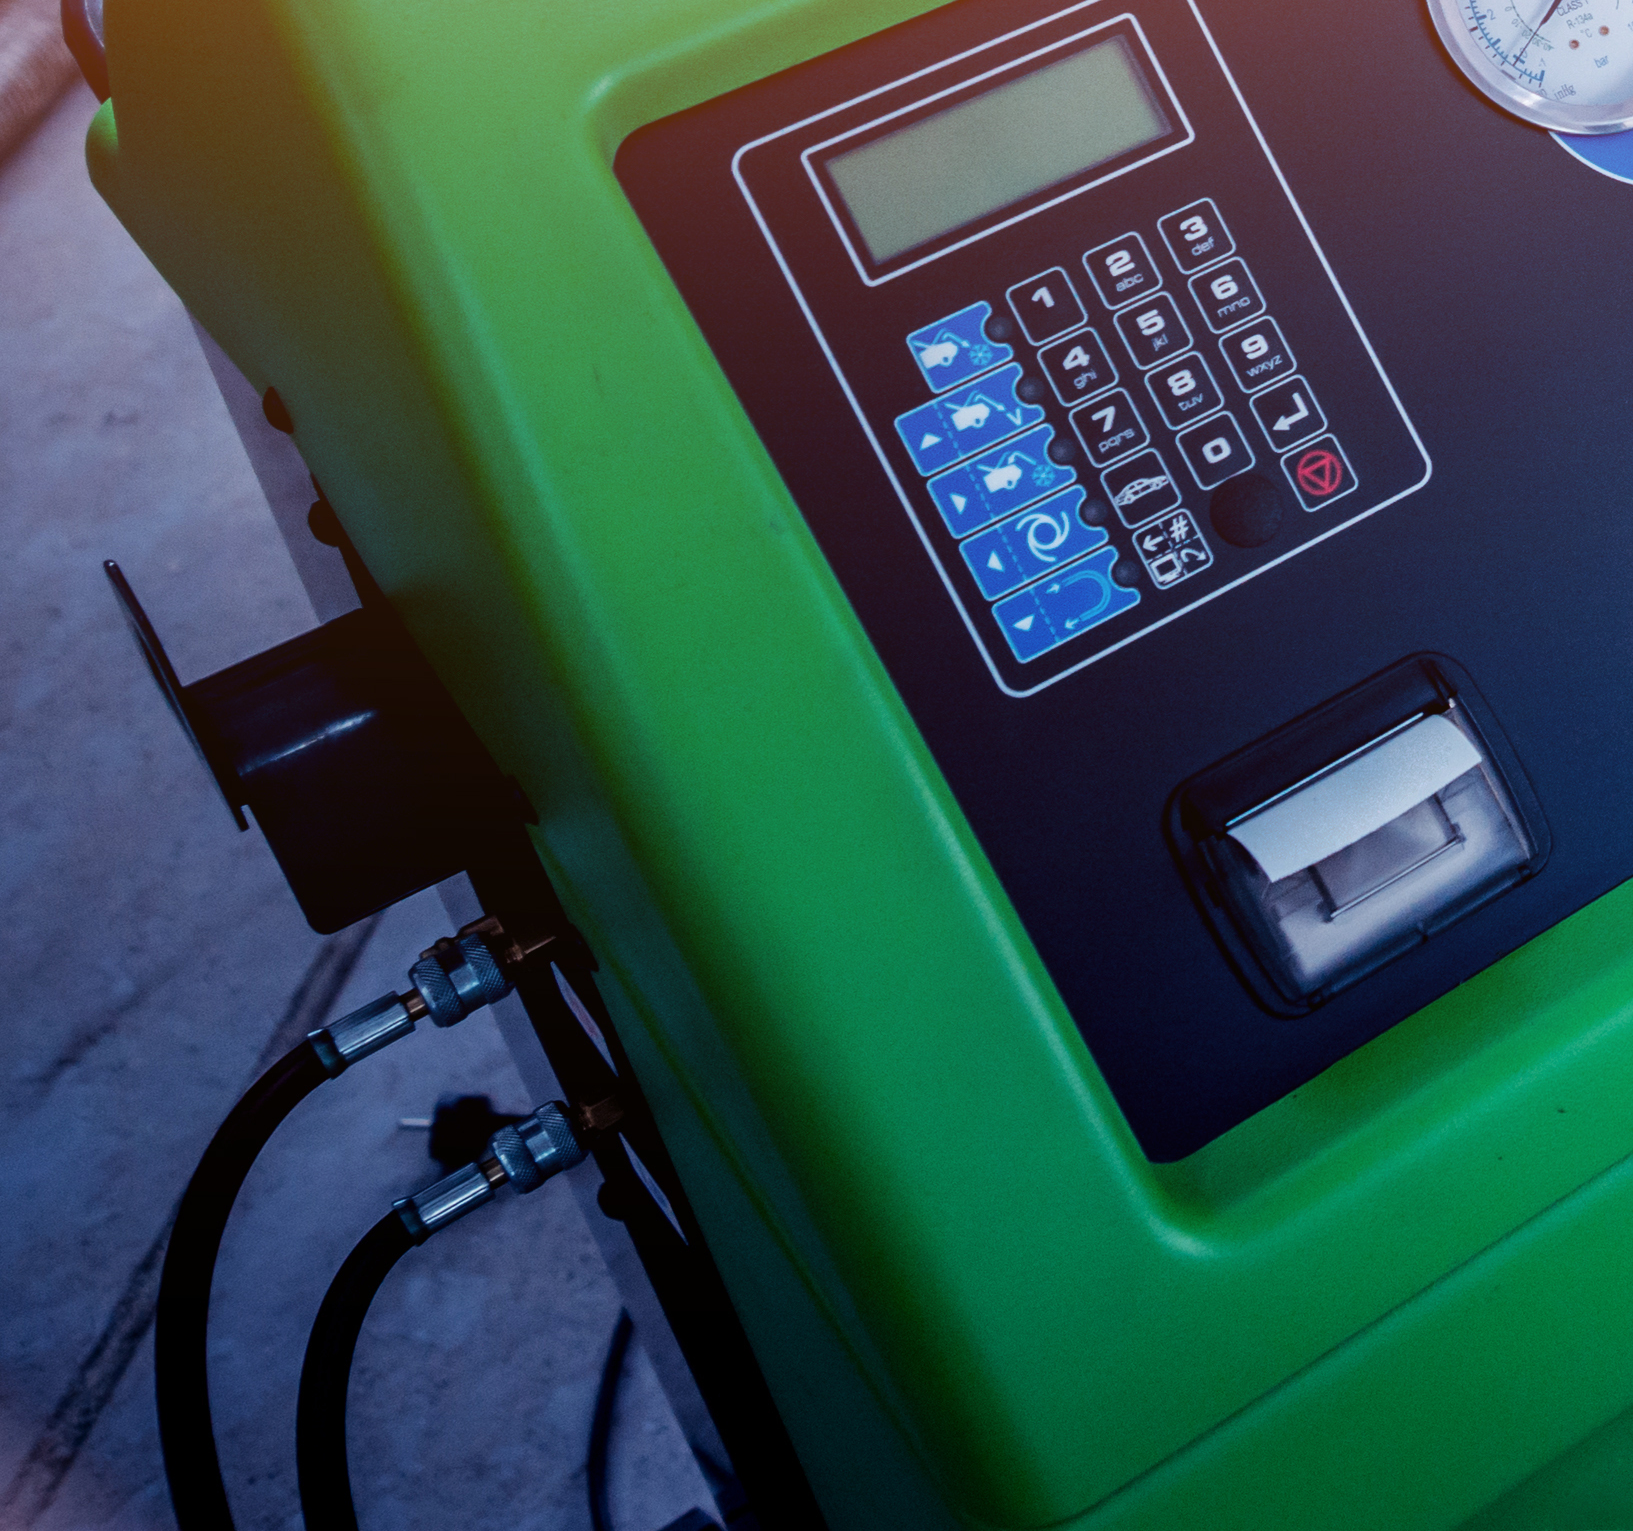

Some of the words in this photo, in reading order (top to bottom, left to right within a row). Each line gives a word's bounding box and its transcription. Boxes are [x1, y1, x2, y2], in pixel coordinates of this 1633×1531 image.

[1486, 8, 1496, 21] 2
[1566, 12, 1594, 29] R-134a
[1594, 55, 1609, 68] bar
[1179, 215, 1209, 241] 3
[1191, 236, 1215, 256] def
[1105, 249, 1136, 277] 2
[1115, 273, 1144, 292] abc
[1210, 274, 1239, 300] 6
[1031, 286, 1055, 308] 1
[1217, 296, 1251, 318] mno
[1135, 309, 1166, 336] 5
[1151, 333, 1169, 352] jkl
[1241, 334, 1269, 360] 9
[1062, 345, 1090, 370] 4
[1246, 354, 1283, 378] wxyz
[1073, 369, 1098, 390] ghi
[1166, 369, 1197, 397] 8
[1177, 392, 1204, 412] tuv
[1091, 405, 1116, 433] 7
[1098, 428, 1135, 453] pqrs
[1202, 436, 1231, 464] 0
